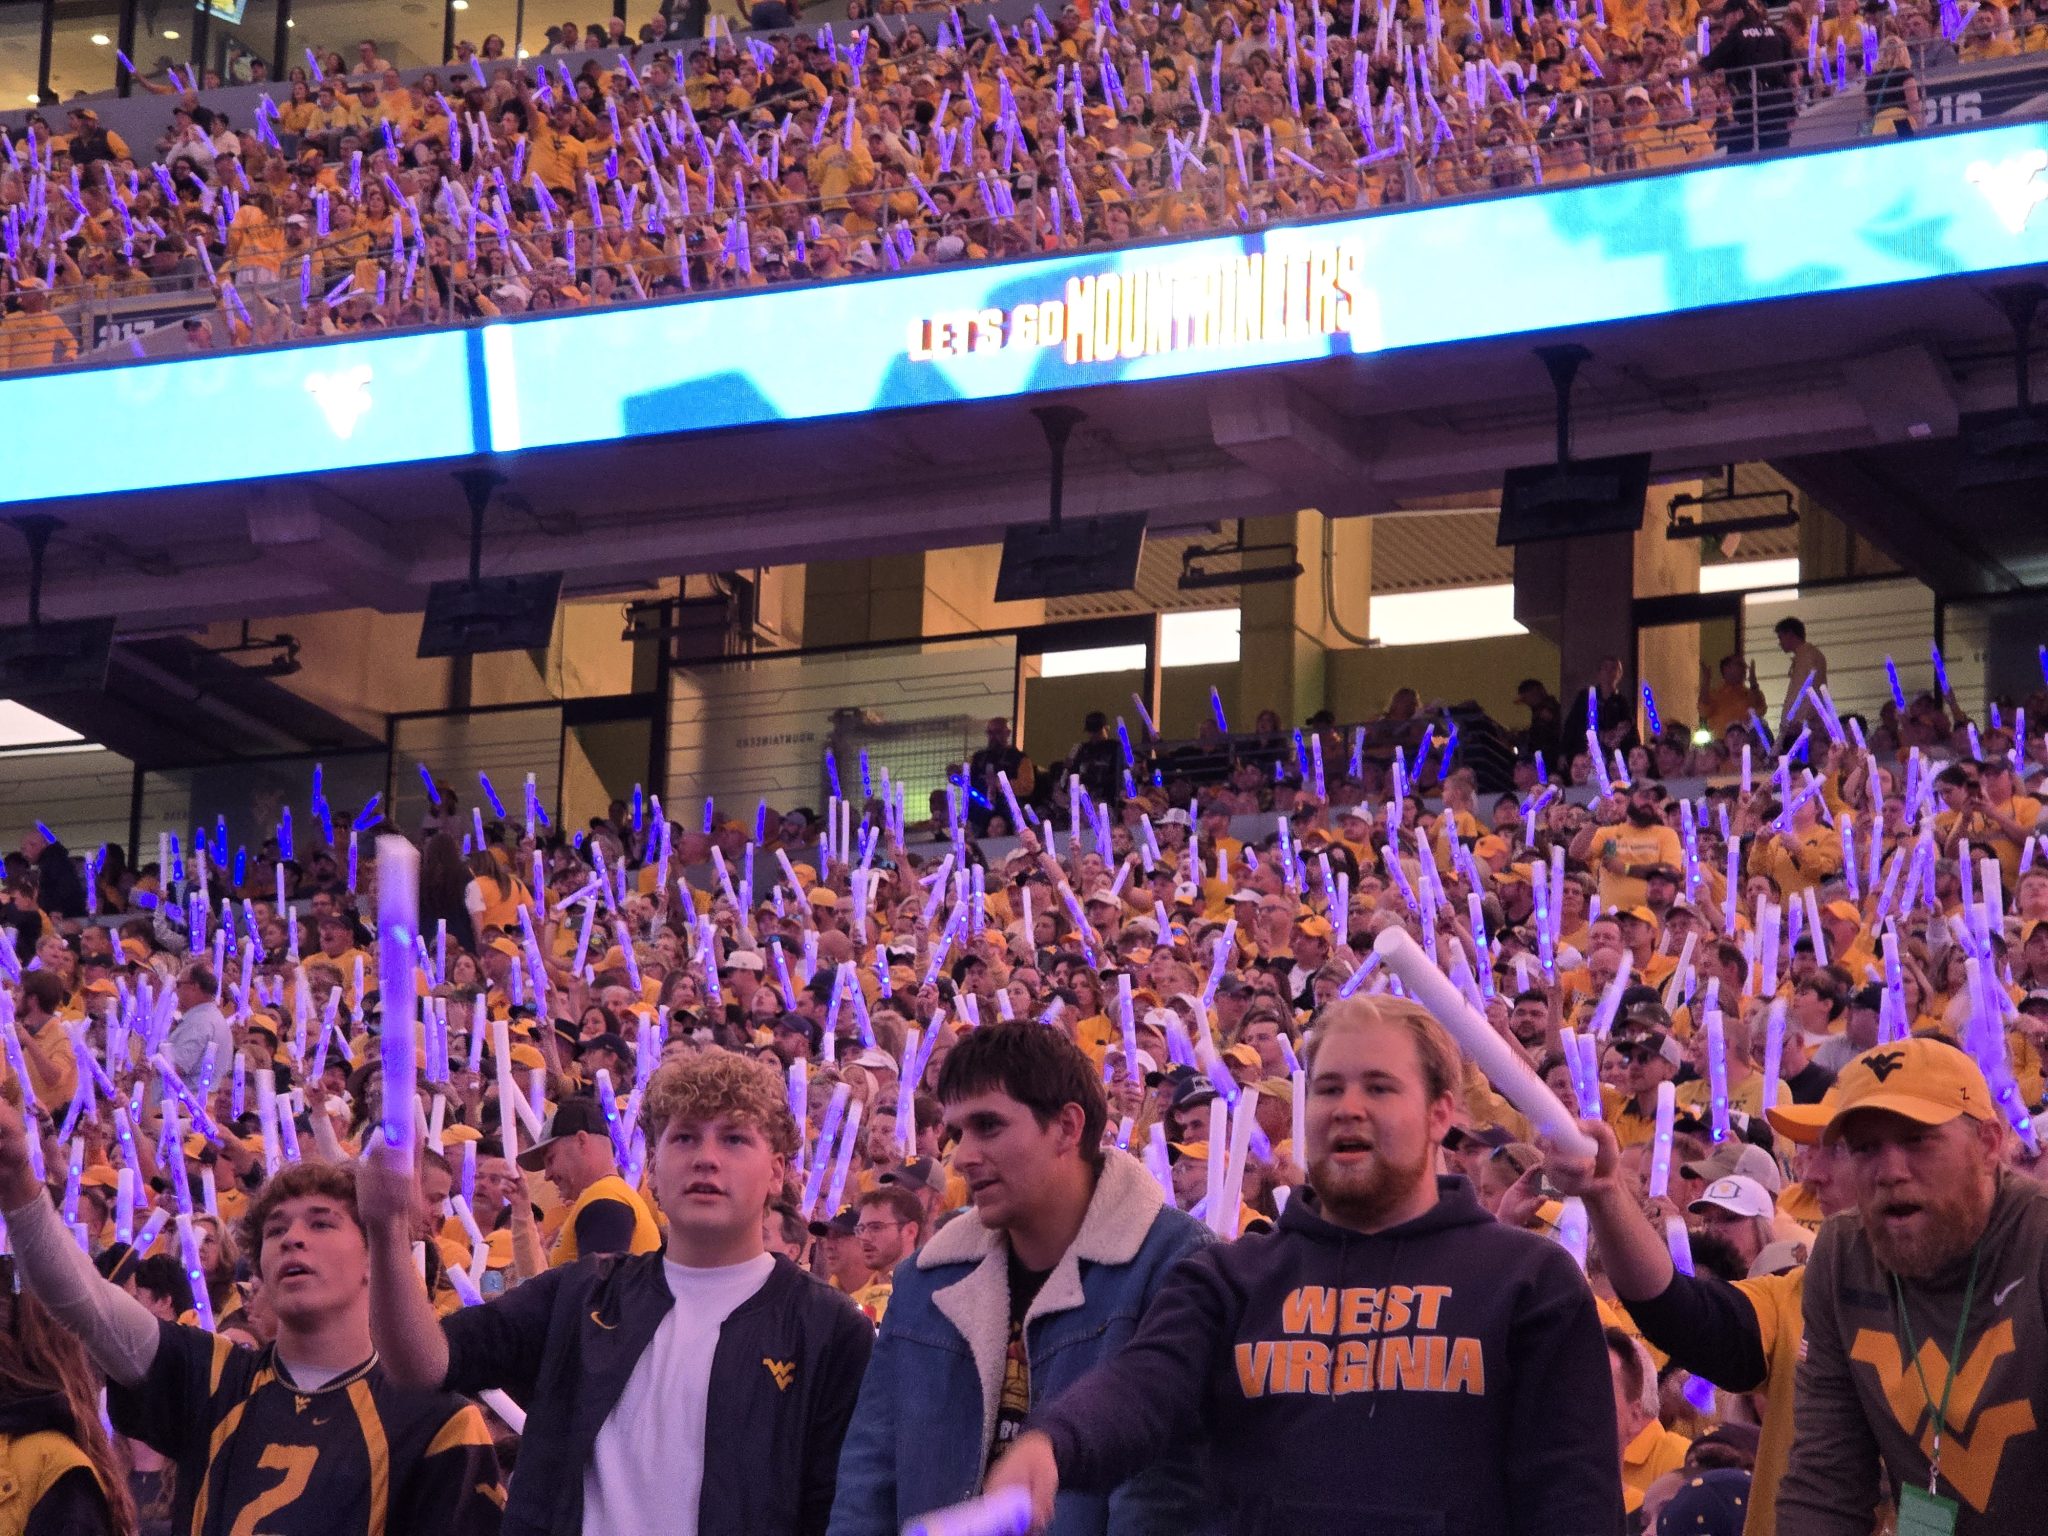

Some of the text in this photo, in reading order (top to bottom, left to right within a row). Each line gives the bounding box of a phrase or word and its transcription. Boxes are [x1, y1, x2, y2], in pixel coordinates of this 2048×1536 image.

[1010, 300, 1065, 350] GO
[1283, 1285, 1452, 1335] WEST
[1235, 1336, 1485, 1398] VIRGINIA
